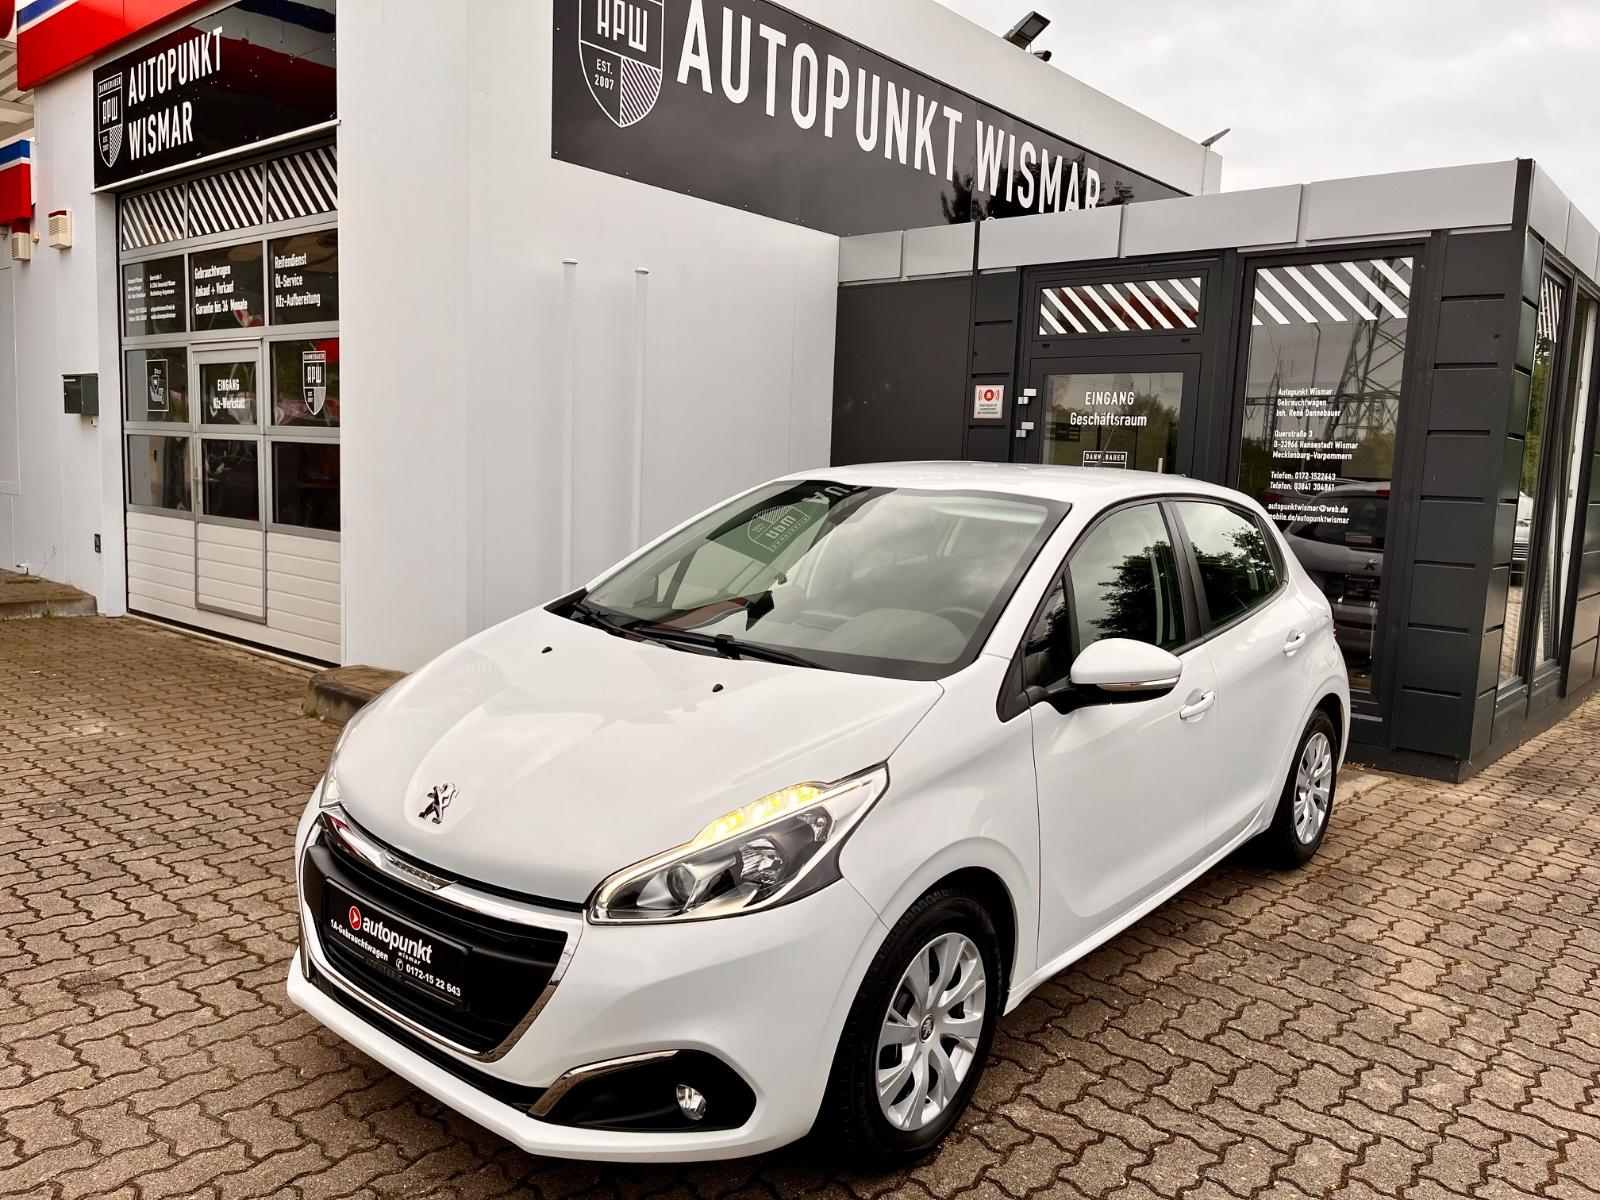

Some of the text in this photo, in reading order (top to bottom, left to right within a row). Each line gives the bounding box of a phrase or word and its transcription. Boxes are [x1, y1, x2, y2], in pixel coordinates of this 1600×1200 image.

[597, 0, 647, 52] APW
[128, 26, 223, 107] AUTOPUNKT
[596, 58, 613, 75] EST.
[594, 74, 614, 90] 2007
[103, 96, 118, 125] APW
[676, 0, 1100, 213] AUTOPUNKT WISMAR
[128, 101, 194, 161] WISMAR
[274, 252, 307, 269] Reifendienst
[194, 265, 231, 279] Gebrauchtwagen
[195, 283, 211, 298] Ankauf
[216, 280, 234, 294] Verkauf
[275, 273, 303, 289] Öl-Service
[195, 301, 214, 315] Garantie
[230, 298, 248, 311] Monate
[275, 291, 321, 308] Kfz-Aufbereitung
[307, 366, 321, 383] APW
[217, 378, 240, 391] EINGANG
[1278, 388, 1308, 397] Autopunkt
[213, 397, 246, 409] Kfz-Werkstatt
[1085, 391, 1135, 405] EINGANG
[1277, 399, 1327, 408] Gebrauchtwagen
[1070, 412, 1147, 427] Geschäftsraum
[1276, 409, 1341, 417] Inh. René Dannebauer
[1274, 430, 1307, 438] Querstraße
[1273, 440, 1358, 449] D-23966 Hansestadt Wismar
[1272, 451, 1352, 460] Mecklenburg-Vorpommern
[1270, 471, 1293, 479] Telefon:
[1270, 481, 1292, 490] Telefon:
[1267, 503, 1348, 514] autopunktwismar@web.de
[330, 918, 389, 961] 1A-Gebrauchtwagen
[362, 916, 433, 964] autopunkt
[398, 951, 421, 966] wismar
[405, 963, 434, 984] 0172-15
[435, 978, 445, 990] 22
[446, 983, 461, 997] 643
